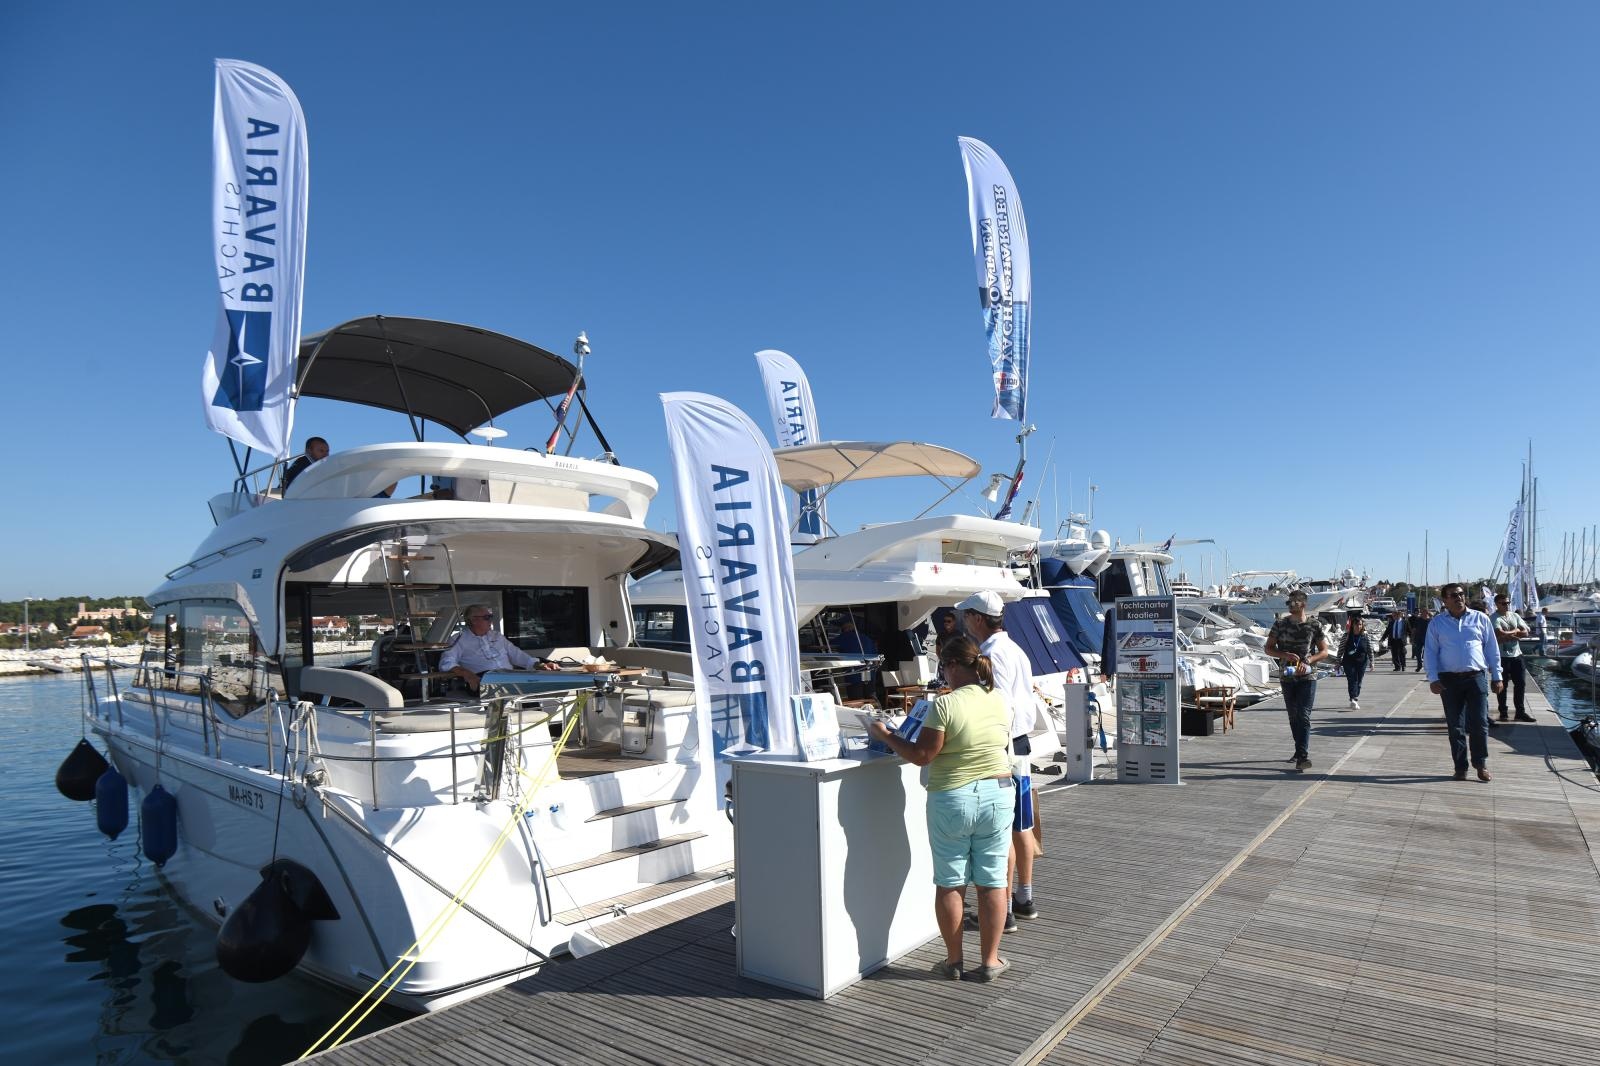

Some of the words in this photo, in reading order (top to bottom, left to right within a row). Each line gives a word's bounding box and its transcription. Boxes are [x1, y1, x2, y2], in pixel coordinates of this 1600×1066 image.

[1119, 601, 1169, 610] Yachtcharter
[1127, 611, 1159, 619] Kroatien
[229, 785, 252, 806] MA-HS
[254, 792, 263, 809] 73
